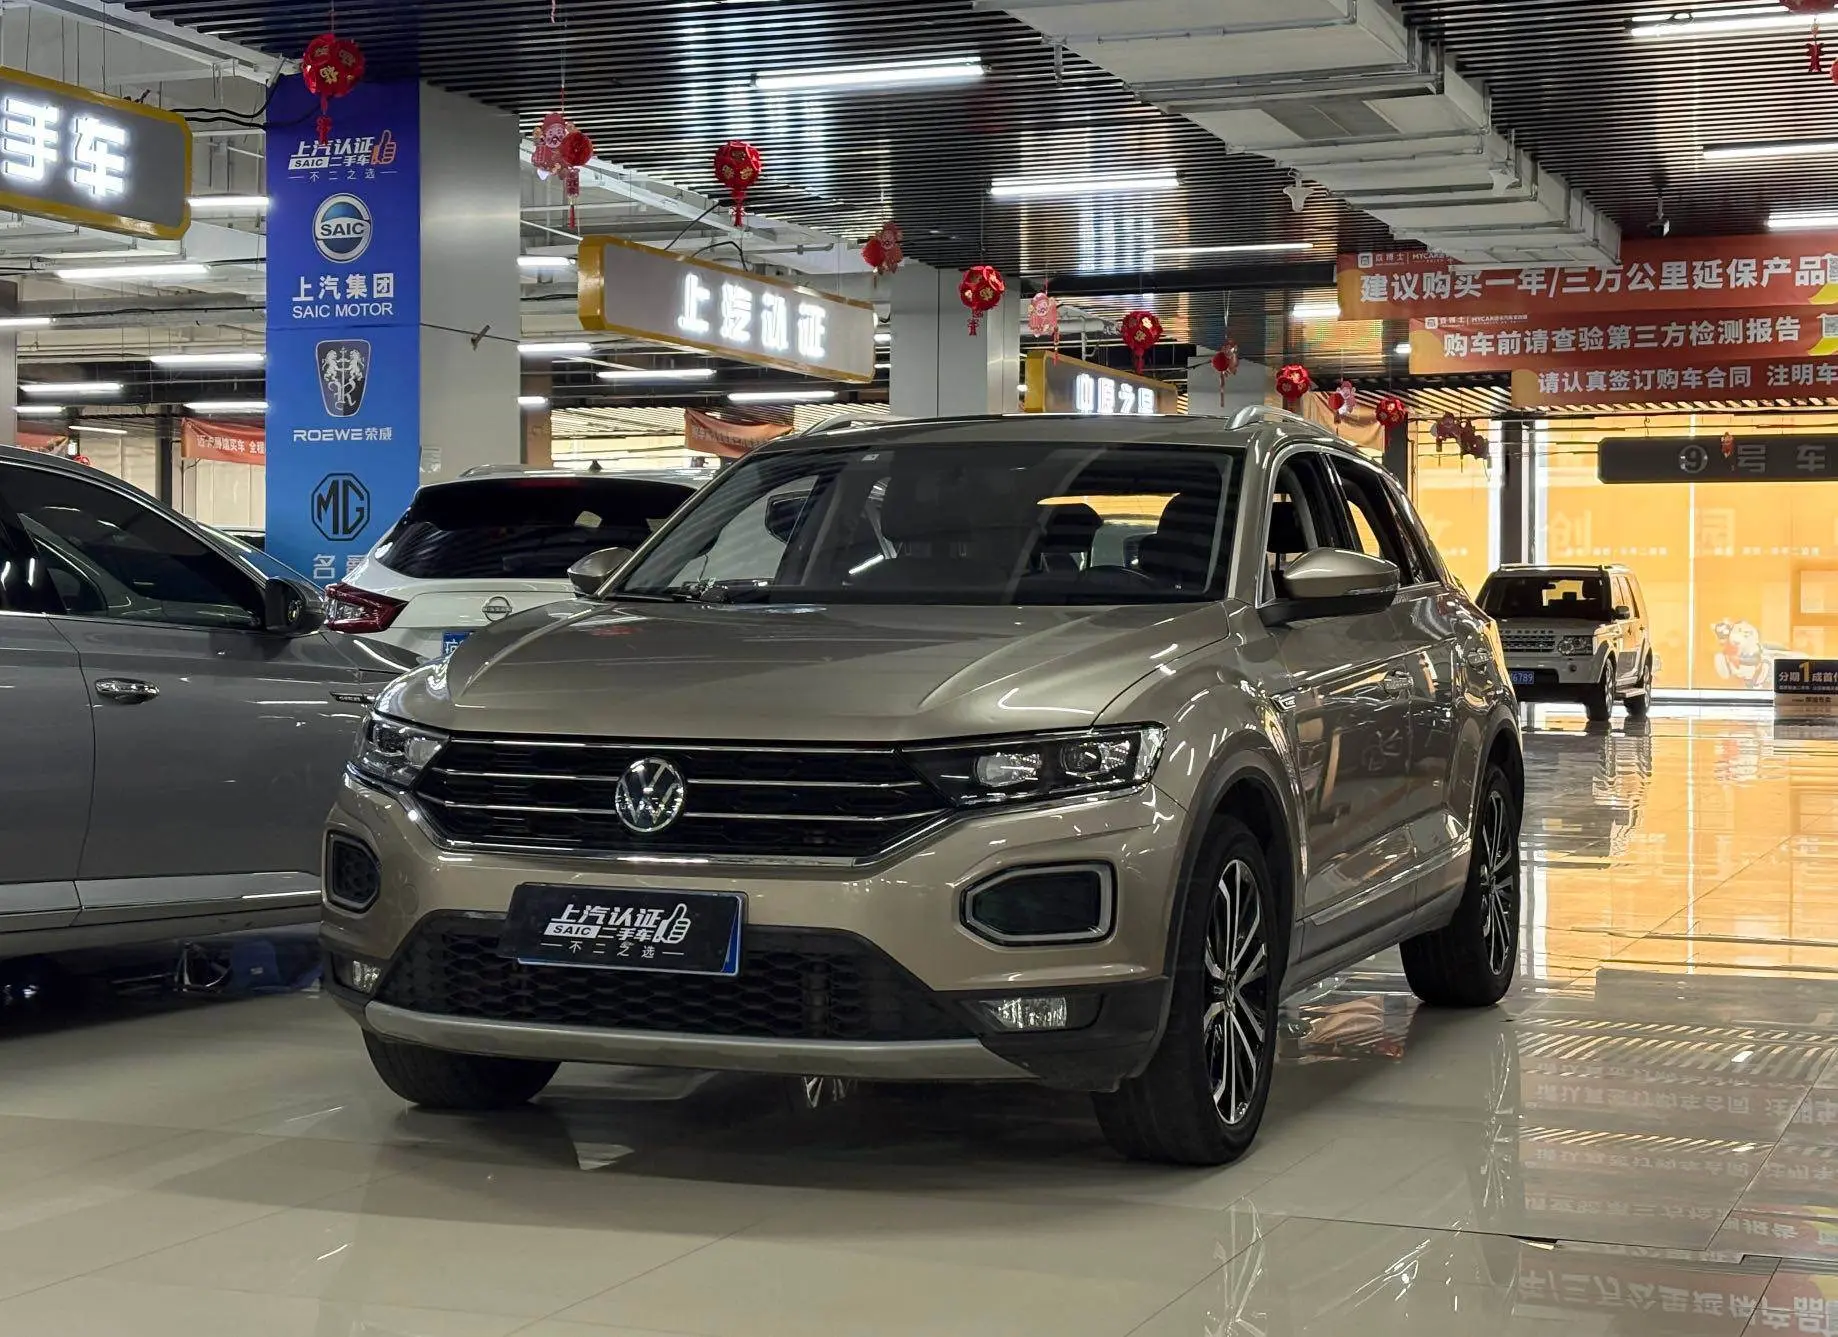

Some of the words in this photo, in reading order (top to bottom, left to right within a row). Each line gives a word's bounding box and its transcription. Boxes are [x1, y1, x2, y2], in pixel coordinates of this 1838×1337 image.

[291, 136, 375, 157] 上汽认证
[294, 159, 324, 168] SAIC
[329, 155, 371, 167] 二手车
[309, 169, 376, 182] 不二之选
[320, 223, 365, 237] SAIC
[292, 272, 394, 302] 上汽集团
[1360, 255, 1826, 303] 建议购买一年/三万公里延保产品
[292, 305, 331, 319] SAIC
[335, 302, 393, 317] MOTOR
[1444, 316, 1801, 357] 购车前请查验第三方检测报告
[1538, 365, 1752, 394] 请认真签订购车合同
[293, 428, 363, 442] ROEWE
[364, 426, 393, 441] 荣威
[315, 478, 366, 537] MG
[550, 903, 665, 929] 上汽认证
[553, 924, 592, 936] SAIC
[598, 927, 655, 942] 二手车
[568, 941, 655, 958] 不二之选
